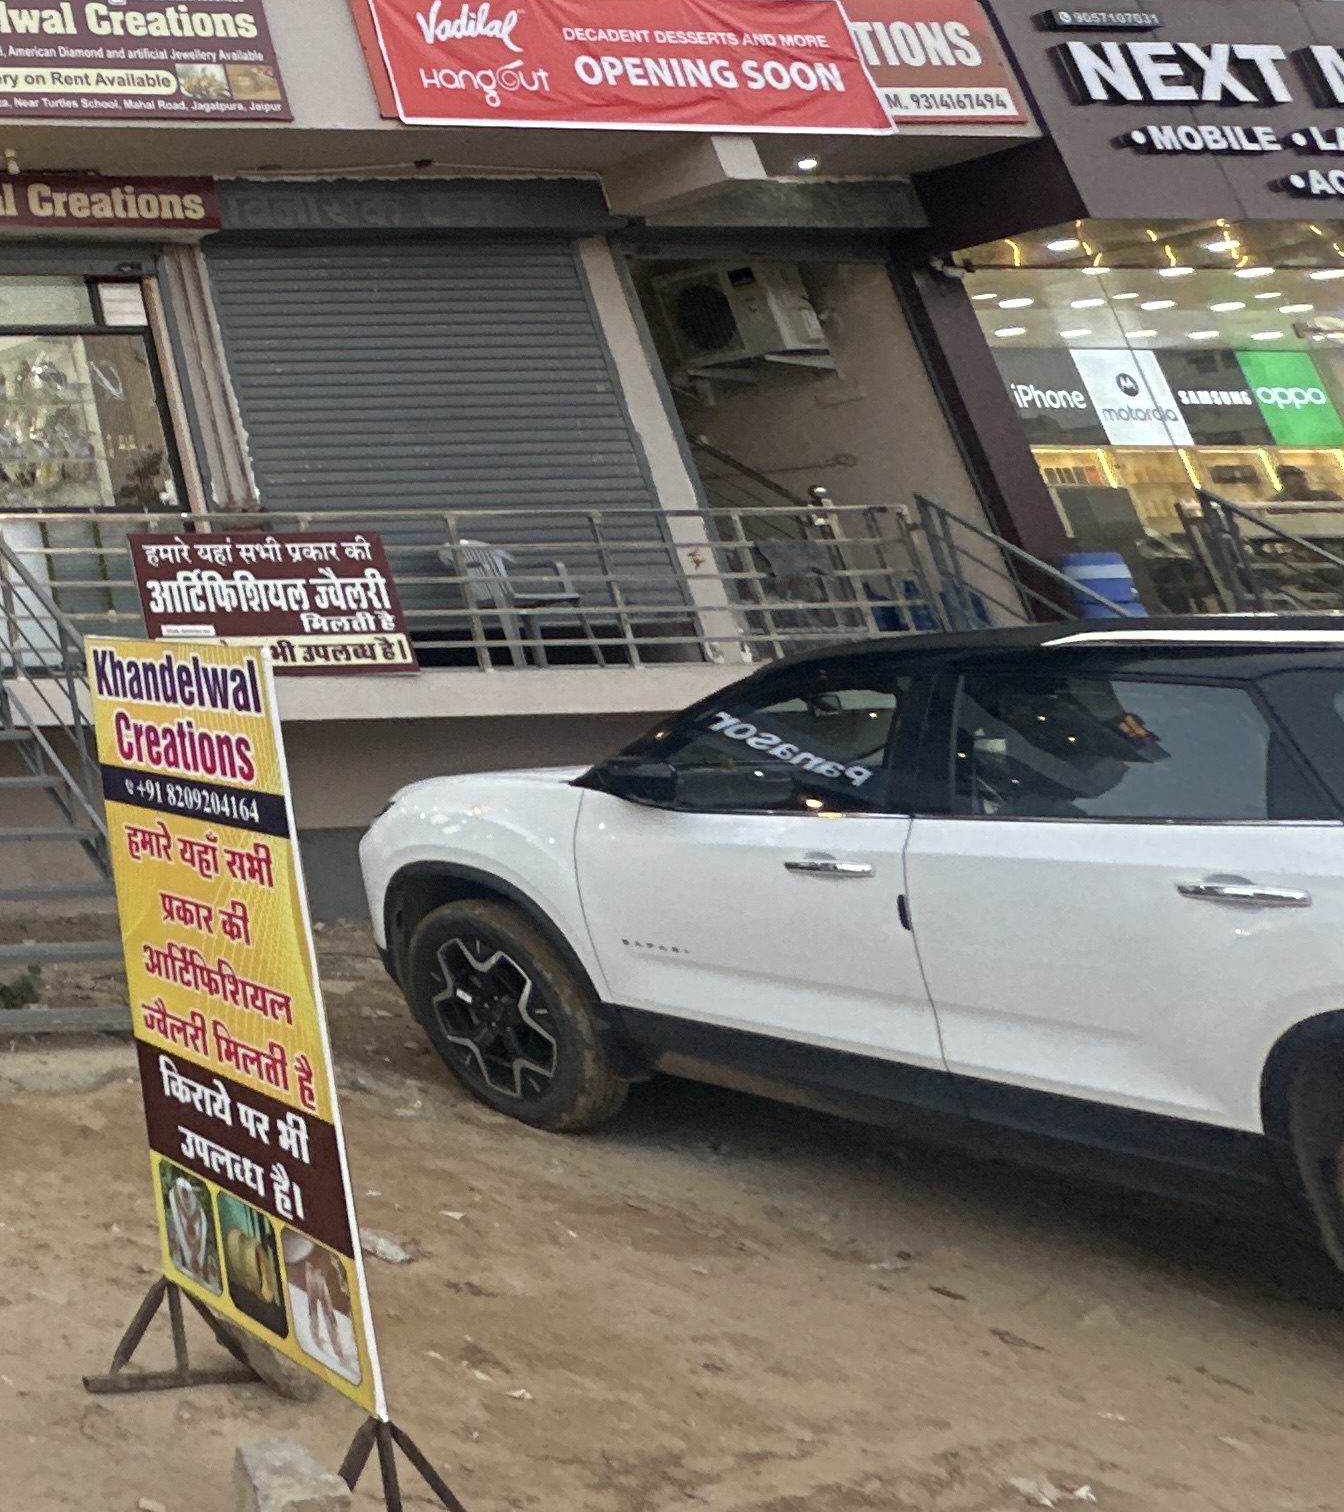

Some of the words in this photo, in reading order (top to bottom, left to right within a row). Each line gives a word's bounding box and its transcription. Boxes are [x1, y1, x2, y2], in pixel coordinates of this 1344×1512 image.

[84, 2, 258, 39] Creations
[416, 0, 524, 52] Vadilal
[562, 27, 649, 43] DECADENT
[655, 30, 736, 45] DESSERTS
[742, 33, 777, 47] AND
[781, 34, 830, 48] MORE
[8, 45, 56, 57] American
[59, 46, 105, 58] Diamond
[107, 48, 126, 59] and
[128, 48, 167, 60] artificial
[170, 49, 217, 62] Jewellery
[219, 50, 264, 62] Available
[1065, 41, 1294, 103] NEXT
[24, 73, 46, 85] on
[51, 72, 91, 87] Rent
[94, 74, 171, 88] Available
[419, 59, 551, 107] Hangout
[574, 55, 739, 88] OPENING
[741, 59, 846, 92] SOON
[14, 98, 39, 108] Near
[42, 98, 79, 109] Turtles
[81, 99, 122, 110] School,
[124, 99, 155, 110] Mahal
[158, 100, 189, 111] Road,
[191, 101, 247, 113] Jagatpura,
[249, 102, 282, 113] Jaipur
[885, 93, 909, 110] M.
[912, 93, 1007, 110] 9314167494
[1146, 125, 1283, 152] MOBILE
[26, 184, 206, 220] Creations
[1011, 384, 1086, 409] iPhone
[1103, 406, 1179, 422] motorola
[1178, 390, 1252, 406] SAMSUNG
[1257, 387, 1327, 409] oppo
[142, 536, 192, 567] हमारे
[193, 538, 232, 566] यहां
[235, 537, 283, 564] सभी
[284, 542, 340, 563] प्रकार
[341, 535, 374, 561] की
[146, 568, 310, 614] आर्टिफिशियल
[300, 612, 375, 633] मिलती
[374, 610, 397, 632] है
[92, 649, 262, 714] Khandelwal
[114, 710, 255, 782] Creations
[137, 780, 162, 804] +91
[166, 782, 260, 824] 8209204164
[125, 821, 172, 861] हमारे
[177, 831, 219, 879] यहाँ
[224, 843, 273, 888] सभी
[160, 892, 213, 933] प्रकार
[219, 900, 250, 945] की
[143, 942, 293, 1025] आर्टिफिशियल
[212, 1019, 290, 1091] मिलती
[295, 1054, 316, 1112] है
[159, 1054, 232, 1126] किराये
[237, 1101, 269, 1145] पर
[277, 1111, 310, 1164] भी
